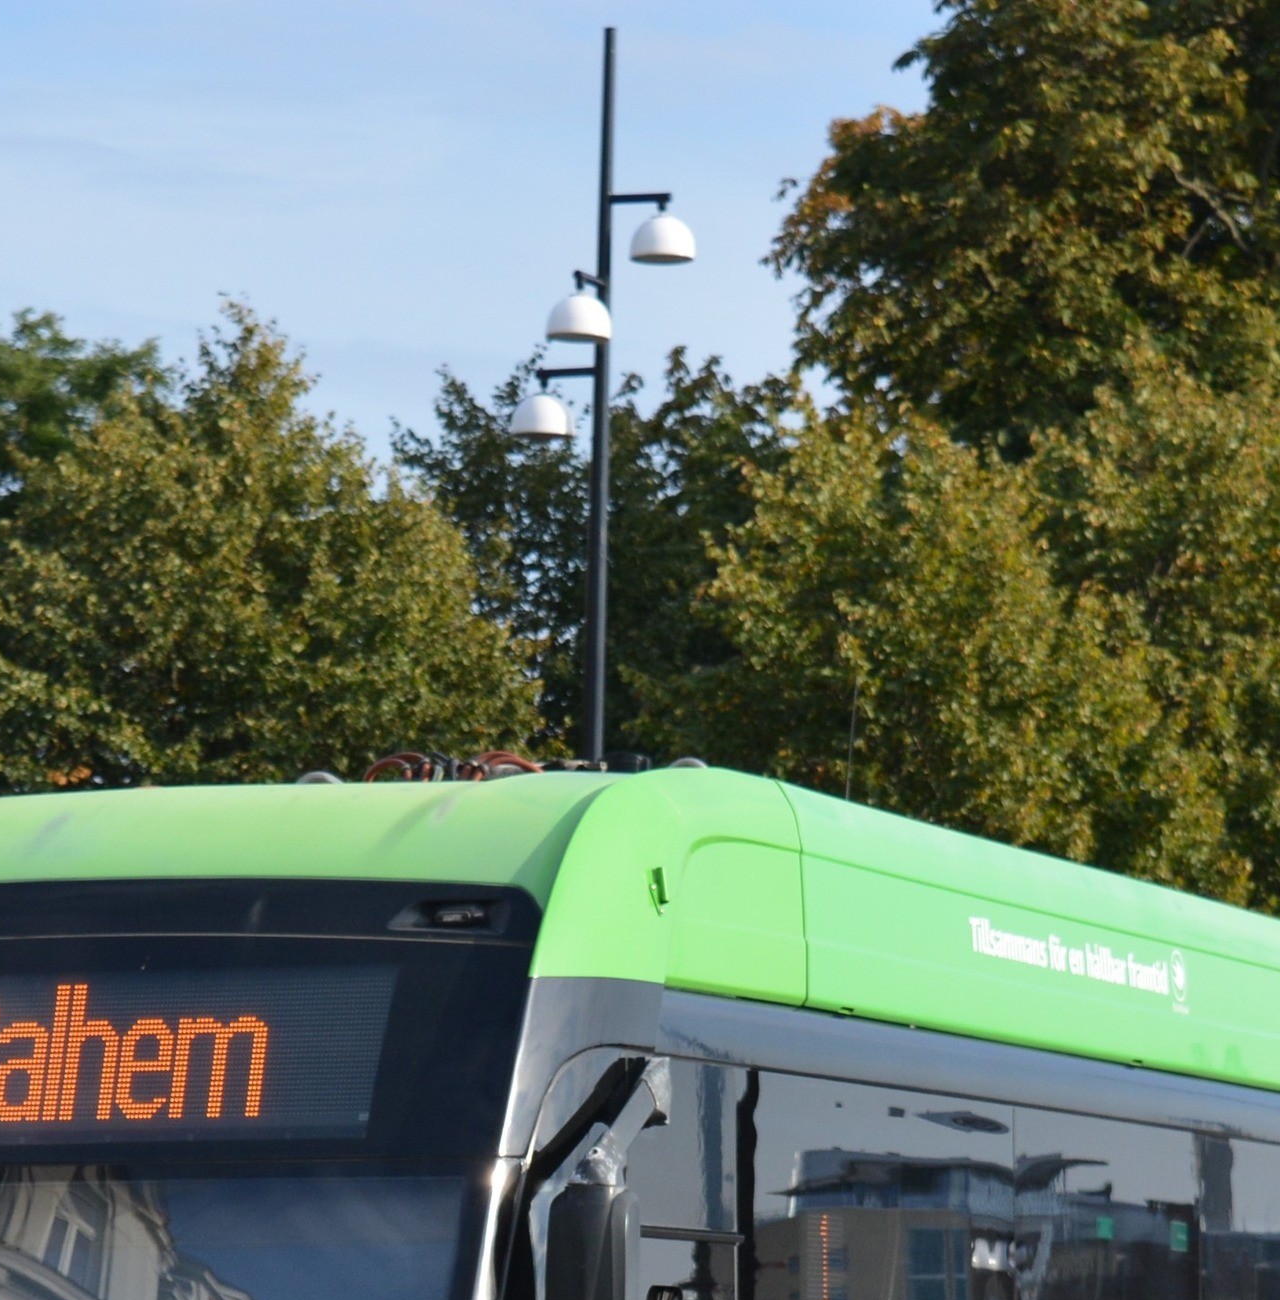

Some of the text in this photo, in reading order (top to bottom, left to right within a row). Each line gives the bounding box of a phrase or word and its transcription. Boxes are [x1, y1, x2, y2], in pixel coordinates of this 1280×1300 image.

[969, 916, 1170, 995] Tillsammans för en hållbar framtid
